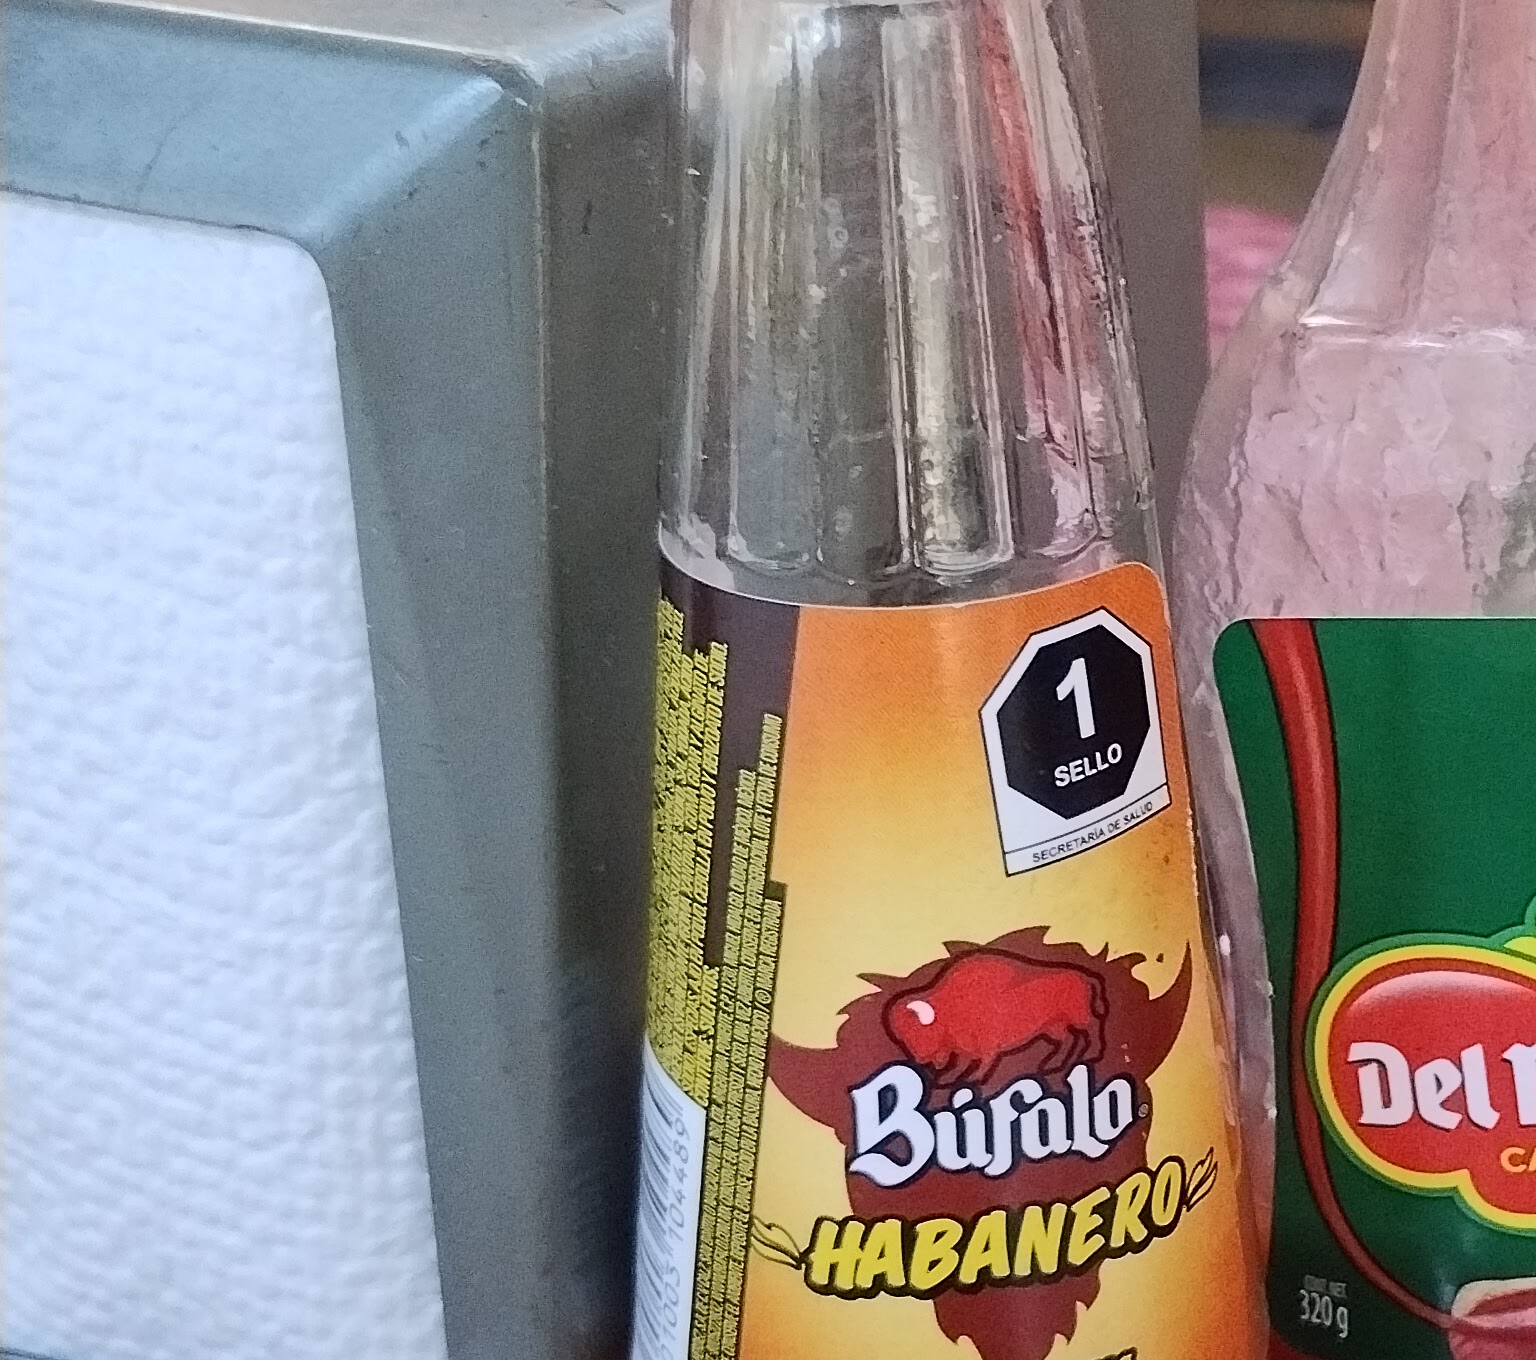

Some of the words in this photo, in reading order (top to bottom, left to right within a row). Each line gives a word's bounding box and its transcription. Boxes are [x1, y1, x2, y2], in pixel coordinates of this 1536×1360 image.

[1056, 657, 1096, 739] 1
[1054, 742, 1123, 787] SELLO
[1107, 818, 1122, 833] DE
[1123, 800, 1154, 826] SALUD
[848, 1064, 1133, 1188] Búfalo
[1347, 1040, 1500, 1131] Del
[806, 1158, 1186, 1292] HABANERO
[1299, 1289, 1333, 1326] 320
